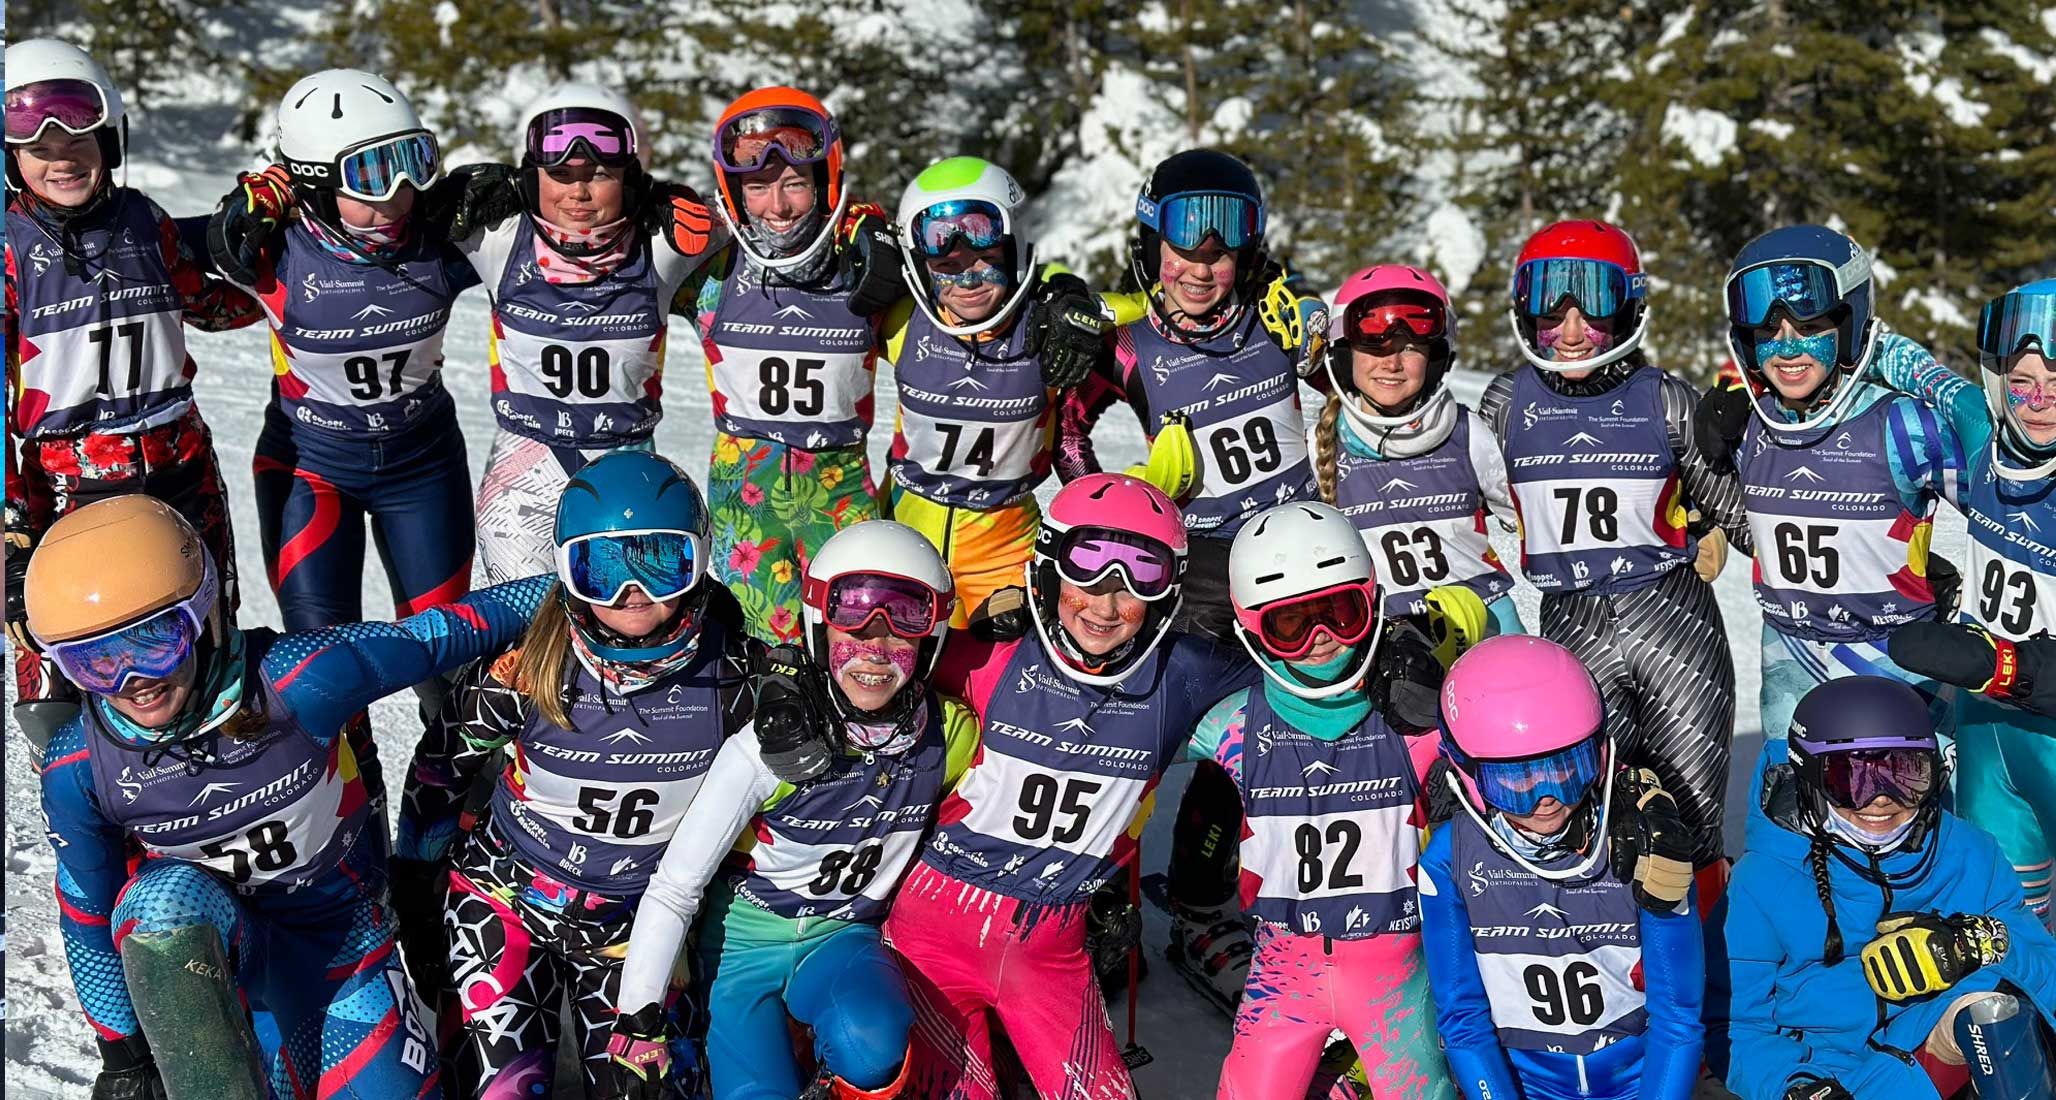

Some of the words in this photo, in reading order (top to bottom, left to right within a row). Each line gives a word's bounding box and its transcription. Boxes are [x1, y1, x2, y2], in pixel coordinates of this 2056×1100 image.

[31, 295, 94, 319] TEAM
[100, 284, 171, 304] SUMMIT
[504, 303, 559, 324] TEAM
[560, 312, 649, 327] SUMMIT
[295, 326, 356, 340] TEAM
[360, 308, 445, 337] SUMMIT
[602, 323, 649, 333] COLORADO
[722, 322, 775, 335] TEAM
[778, 326, 865, 339] SUMMIT
[89, 321, 145, 394] 77
[819, 339, 865, 347] COLORADO
[344, 349, 413, 401] 97
[540, 344, 611, 399] 90
[758, 356, 827, 417] 85
[1215, 371, 1288, 407] SUMMIT
[901, 383, 950, 402] TEAM
[952, 395, 1039, 409] SUMMIT
[1255, 382, 1290, 401] COLORADO
[934, 422, 996, 477] 74
[1209, 416, 1283, 485] 69
[1513, 454, 1565, 468] TEAM
[1568, 453, 1660, 464] SUMMIT
[1611, 464, 1662, 472] COLORADO
[1388, 492, 1469, 509] SUMMIT
[1743, 484, 1786, 498] TEAM
[1789, 489, 1886, 504] SUMMIT
[1831, 503, 1886, 512] COLORADO
[1553, 486, 1618, 545] 78
[1969, 507, 2006, 535] TEAM
[1381, 526, 1450, 587] 63
[1774, 522, 1840, 589] 65
[1980, 558, 2037, 635] 93
[1999, 649, 2013, 687] LEKI
[639, 707, 651, 715] The
[651, 706, 675, 714] Summit
[675, 705, 709, 713] Foundation
[532, 741, 600, 763] TEAM
[605, 748, 712, 765] SUMMIT
[990, 719, 1054, 747] TEAM
[1055, 740, 1152, 761] SUMMIT
[657, 759, 710, 774] COLORADO
[1098, 758, 1149, 771] COLORADO
[207, 758, 312, 821] SUMMIT
[263, 767, 319, 808] COLORADO
[1250, 786, 1304, 799] TEAM
[1307, 776, 1402, 797] SUMMIT
[1350, 790, 1404, 802] COLORADO
[572, 786, 660, 839] 56
[781, 814, 842, 831] TEAM
[1012, 773, 1103, 844] 95
[200, 820, 298, 884] 58
[1201, 823, 1223, 859] LEKI
[1294, 819, 1364, 894] 82
[558, 857, 583, 877] BRECK
[808, 844, 884, 896] 88
[1535, 923, 1636, 938] SUMMIT
[1580, 933, 1637, 944] COLORADO
[1522, 961, 1605, 1026] 96
[1967, 1024, 1994, 1076] SHRED
